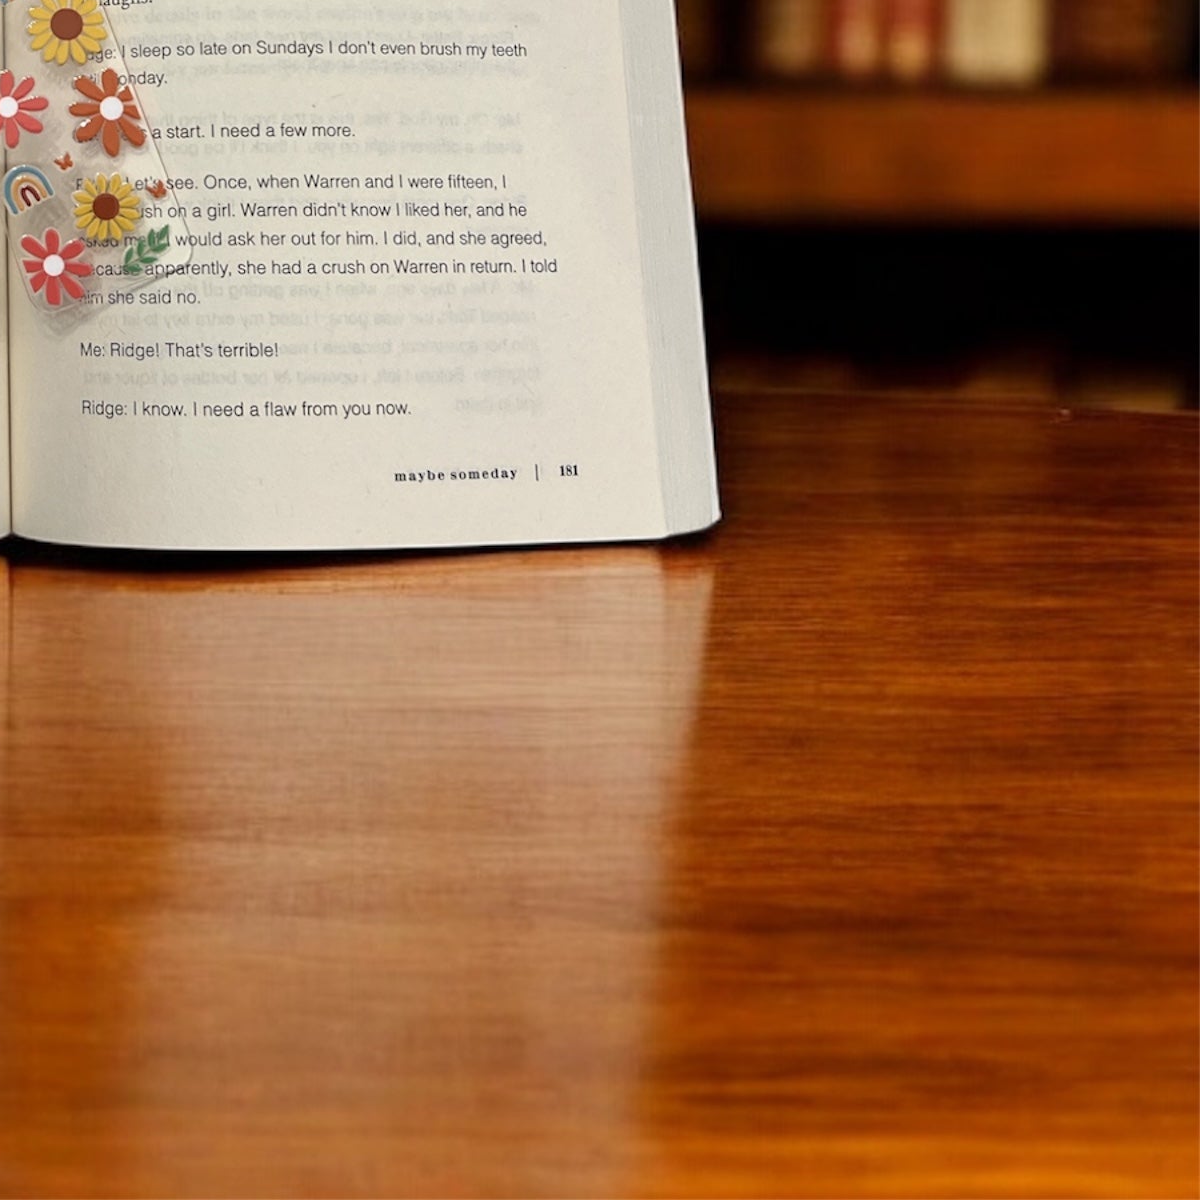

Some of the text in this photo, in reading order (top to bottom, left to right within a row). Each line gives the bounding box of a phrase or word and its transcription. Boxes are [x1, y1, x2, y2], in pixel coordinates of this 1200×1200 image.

[130, 43, 171, 60] sleep
[177, 45, 195, 57] so
[200, 41, 227, 56] late
[232, 43, 251, 55] on
[256, 39, 324, 58] Sundays
[338, 40, 376, 55] don't
[380, 43, 415, 56] even
[420, 41, 462, 56] brush
[466, 45, 487, 60] my
[492, 43, 527, 58] teeth
[152, 128, 162, 140] a
[166, 124, 205, 139] start.
[221, 122, 260, 138] need
[266, 126, 275, 138] a
[280, 122, 307, 138] few
[312, 125, 355, 138] more.
[108, 290, 135, 305] she
[139, 290, 172, 305] said
[177, 292, 201, 305] no.
[80, 341, 278, 361] Me: Ridge! That's terrible!
[82, 399, 127, 420] Ridge:
[143, 400, 187, 417] know.
[203, 401, 244, 418] need
[249, 404, 260, 417] a
[264, 400, 297, 417] flaw
[302, 400, 338, 417] from
[342, 403, 371, 420] you
[376, 403, 411, 416] now.
[394, 464, 578, 483] maybe someday 181
